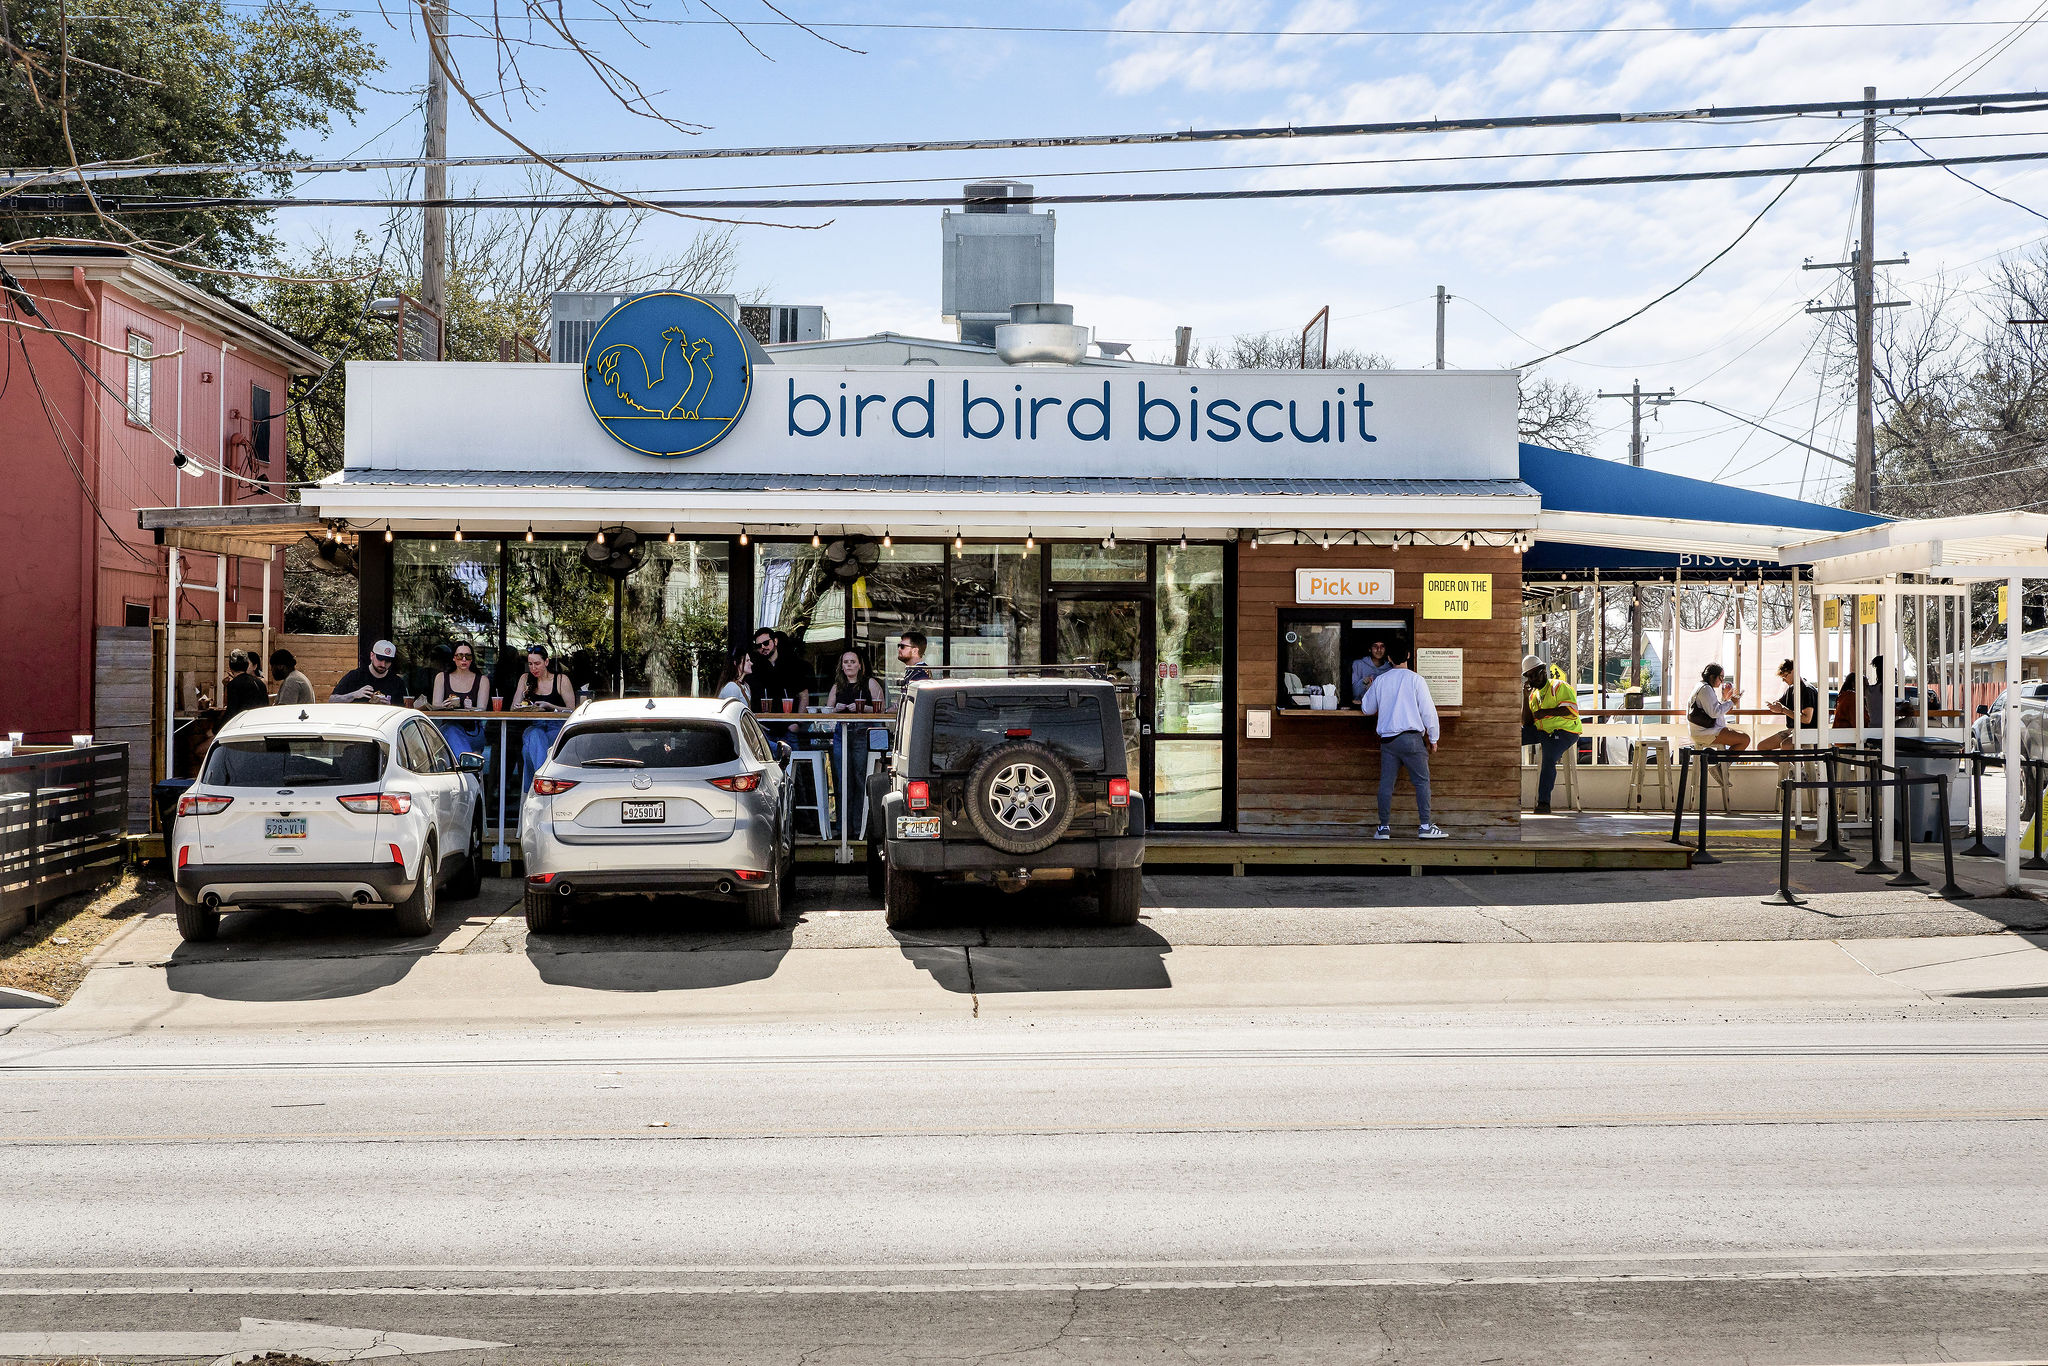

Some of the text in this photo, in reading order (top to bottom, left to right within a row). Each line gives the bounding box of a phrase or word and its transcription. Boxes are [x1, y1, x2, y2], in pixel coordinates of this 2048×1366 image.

[789, 378, 1377, 444] bird bird biscuit
[1680, 553, 1771, 566] BISC
[1311, 578, 1352, 596] Pick
[1428, 580, 1487, 592] ORDER ON THE
[1444, 600, 1469, 612] PATIO
[628, 807, 663, 819] 9259DV1
[911, 823, 939, 833] 2HE424
